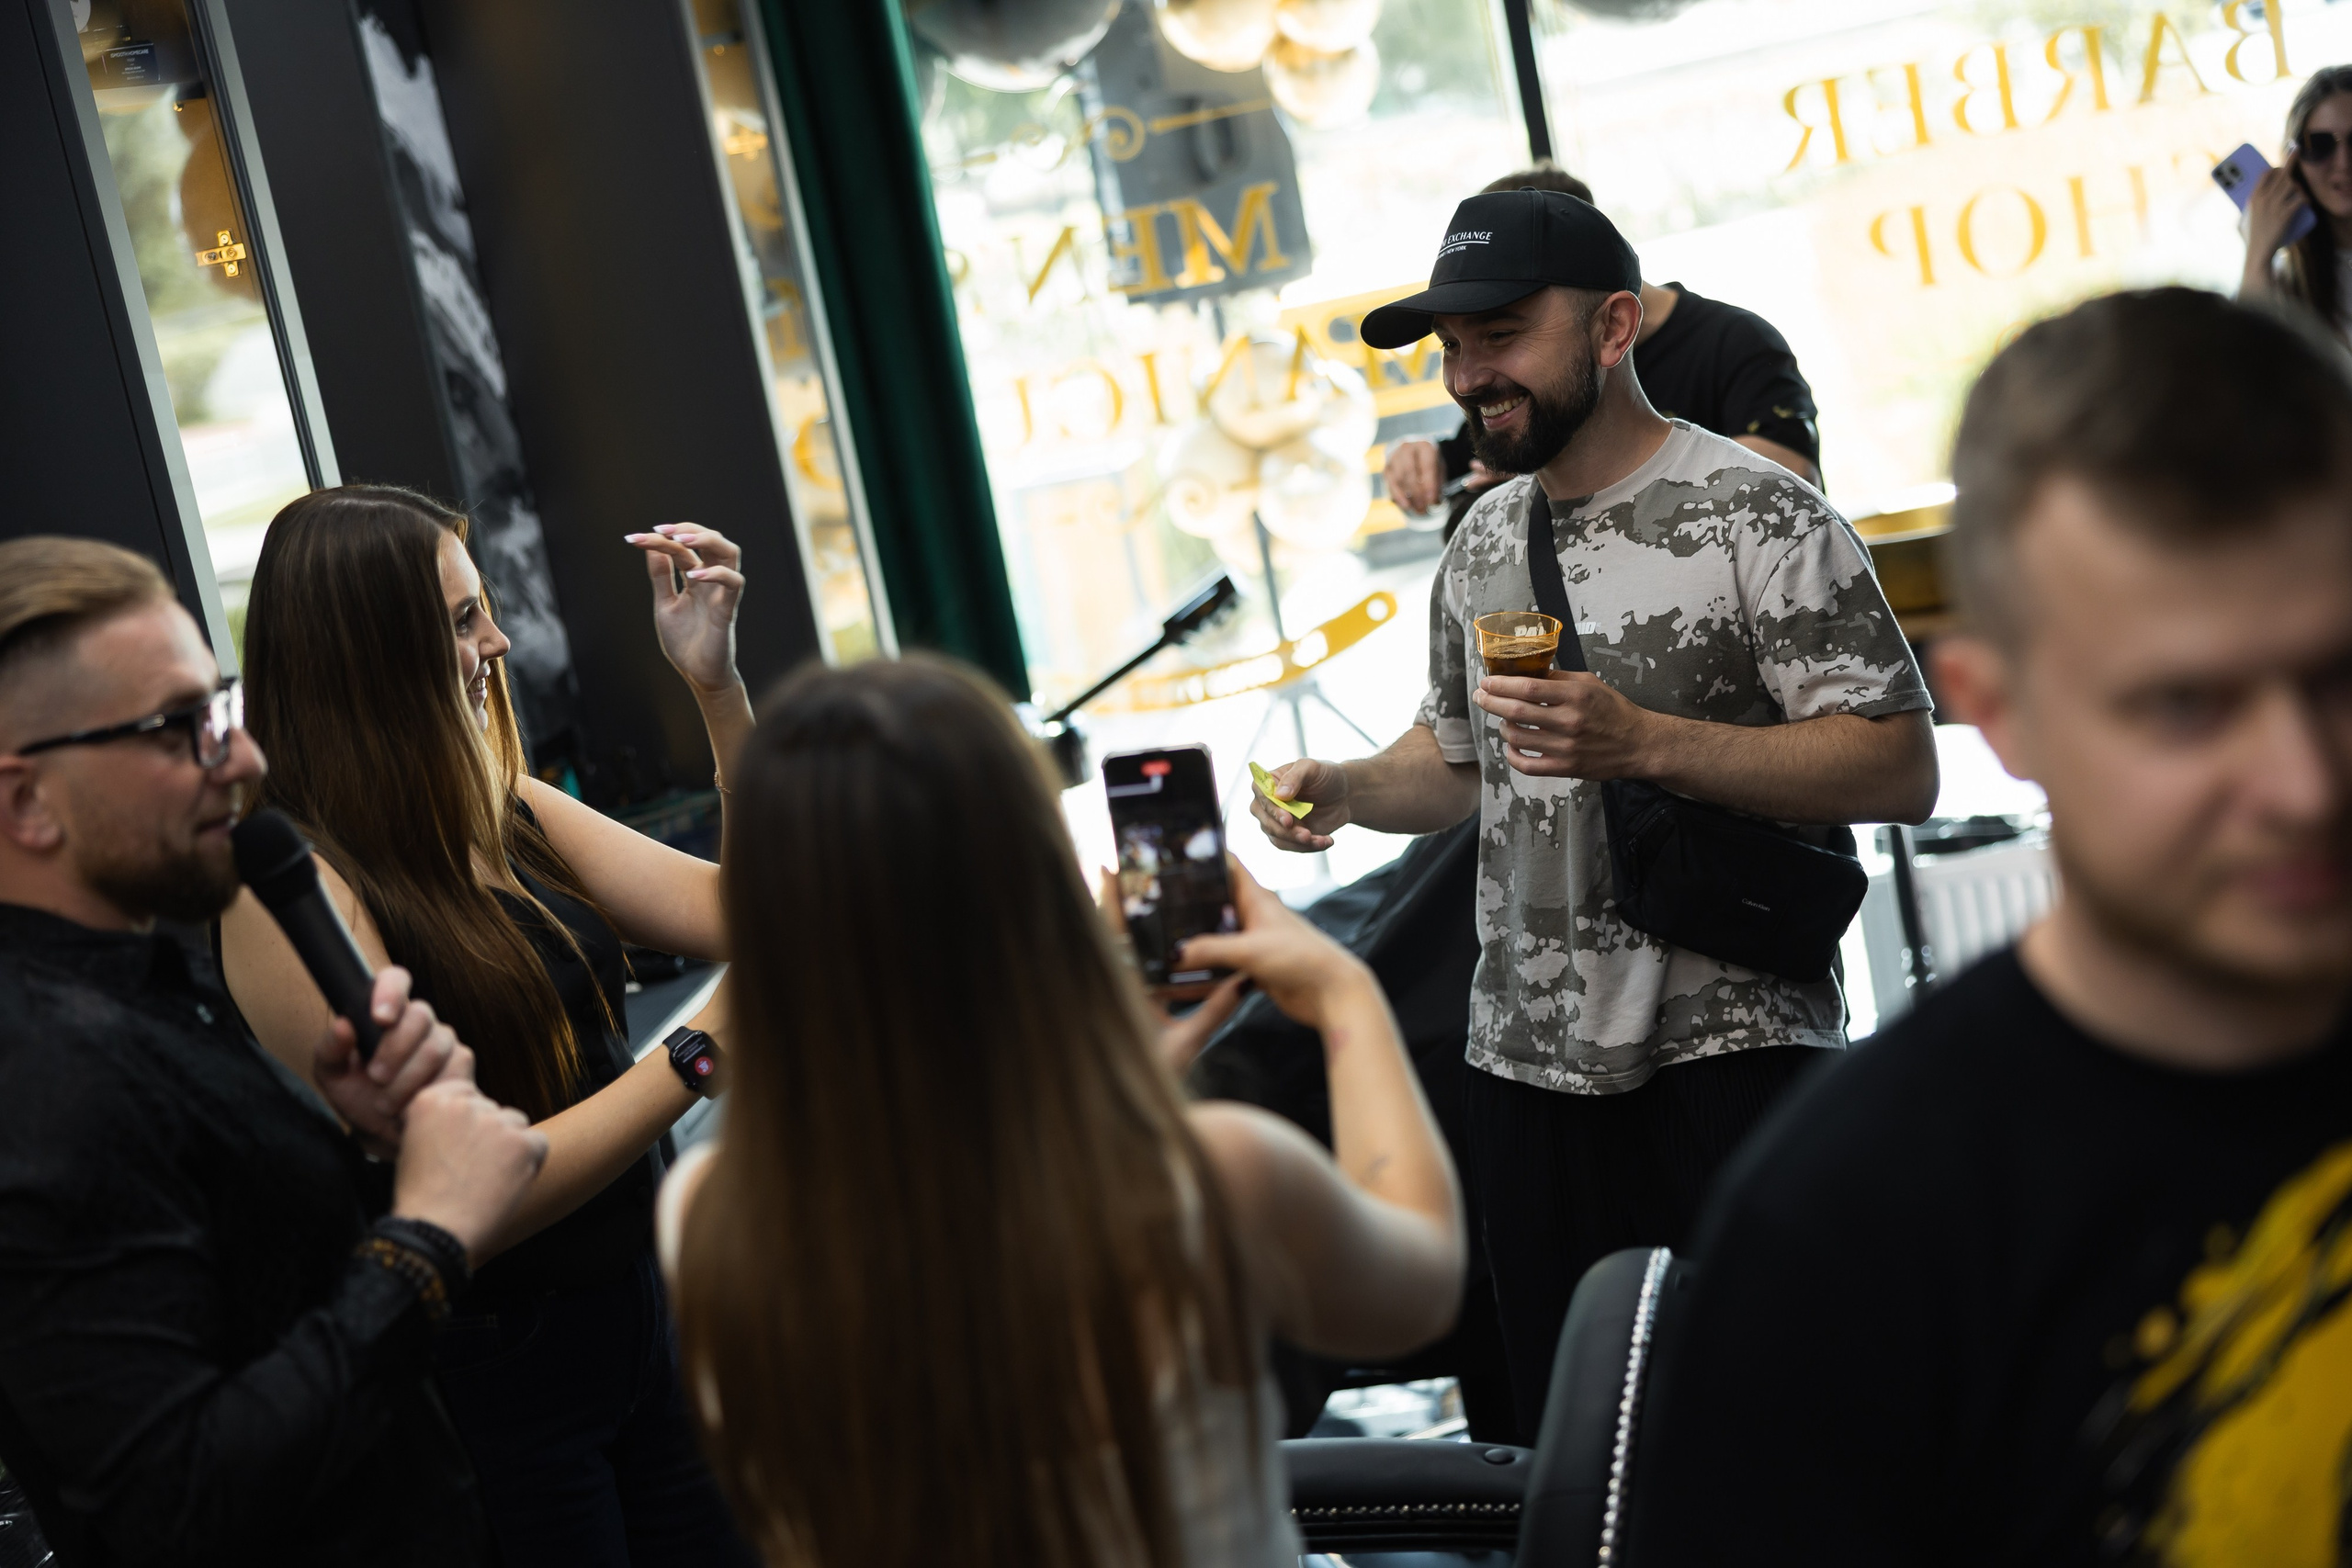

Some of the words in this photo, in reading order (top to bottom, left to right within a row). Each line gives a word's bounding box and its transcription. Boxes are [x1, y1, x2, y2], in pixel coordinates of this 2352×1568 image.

[1447, 231, 1493, 244] EXCHANGE
[1741, 898, 1758, 907] Calvin
[1758, 903, 1770, 912] Klein
